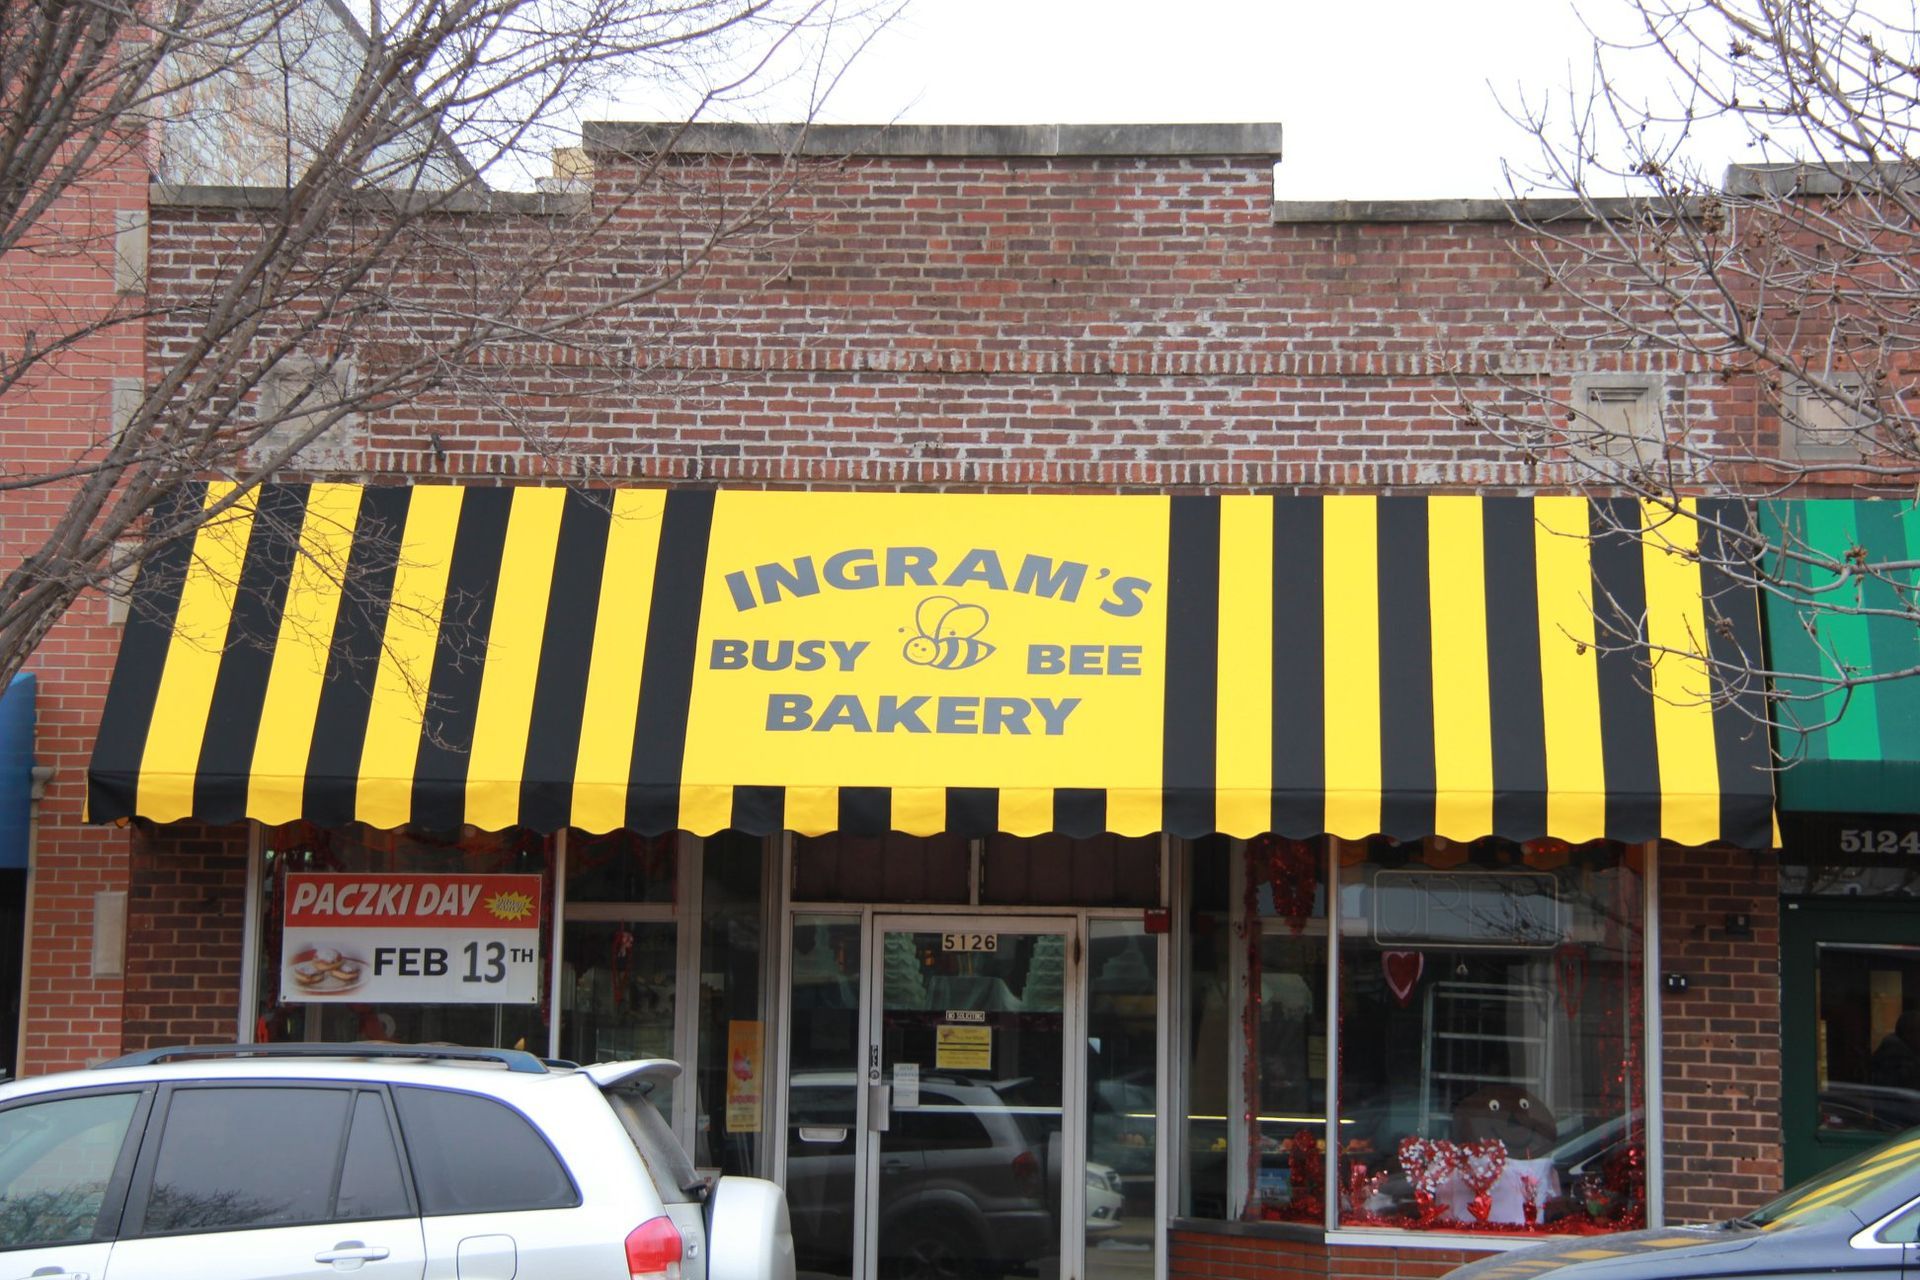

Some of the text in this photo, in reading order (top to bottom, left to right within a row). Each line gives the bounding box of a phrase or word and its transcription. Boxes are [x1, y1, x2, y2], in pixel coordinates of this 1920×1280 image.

[724, 547, 1153, 618] INGRAM'S
[709, 639, 1143, 676] BUSY BEE
[765, 693, 1083, 736] BAKERY
[1840, 829, 1920, 854] 5124
[291, 882, 413, 916] PACZKI
[415, 884, 482, 916] DAY
[944, 934, 996, 950] 5126
[373, 947, 448, 976] FEB
